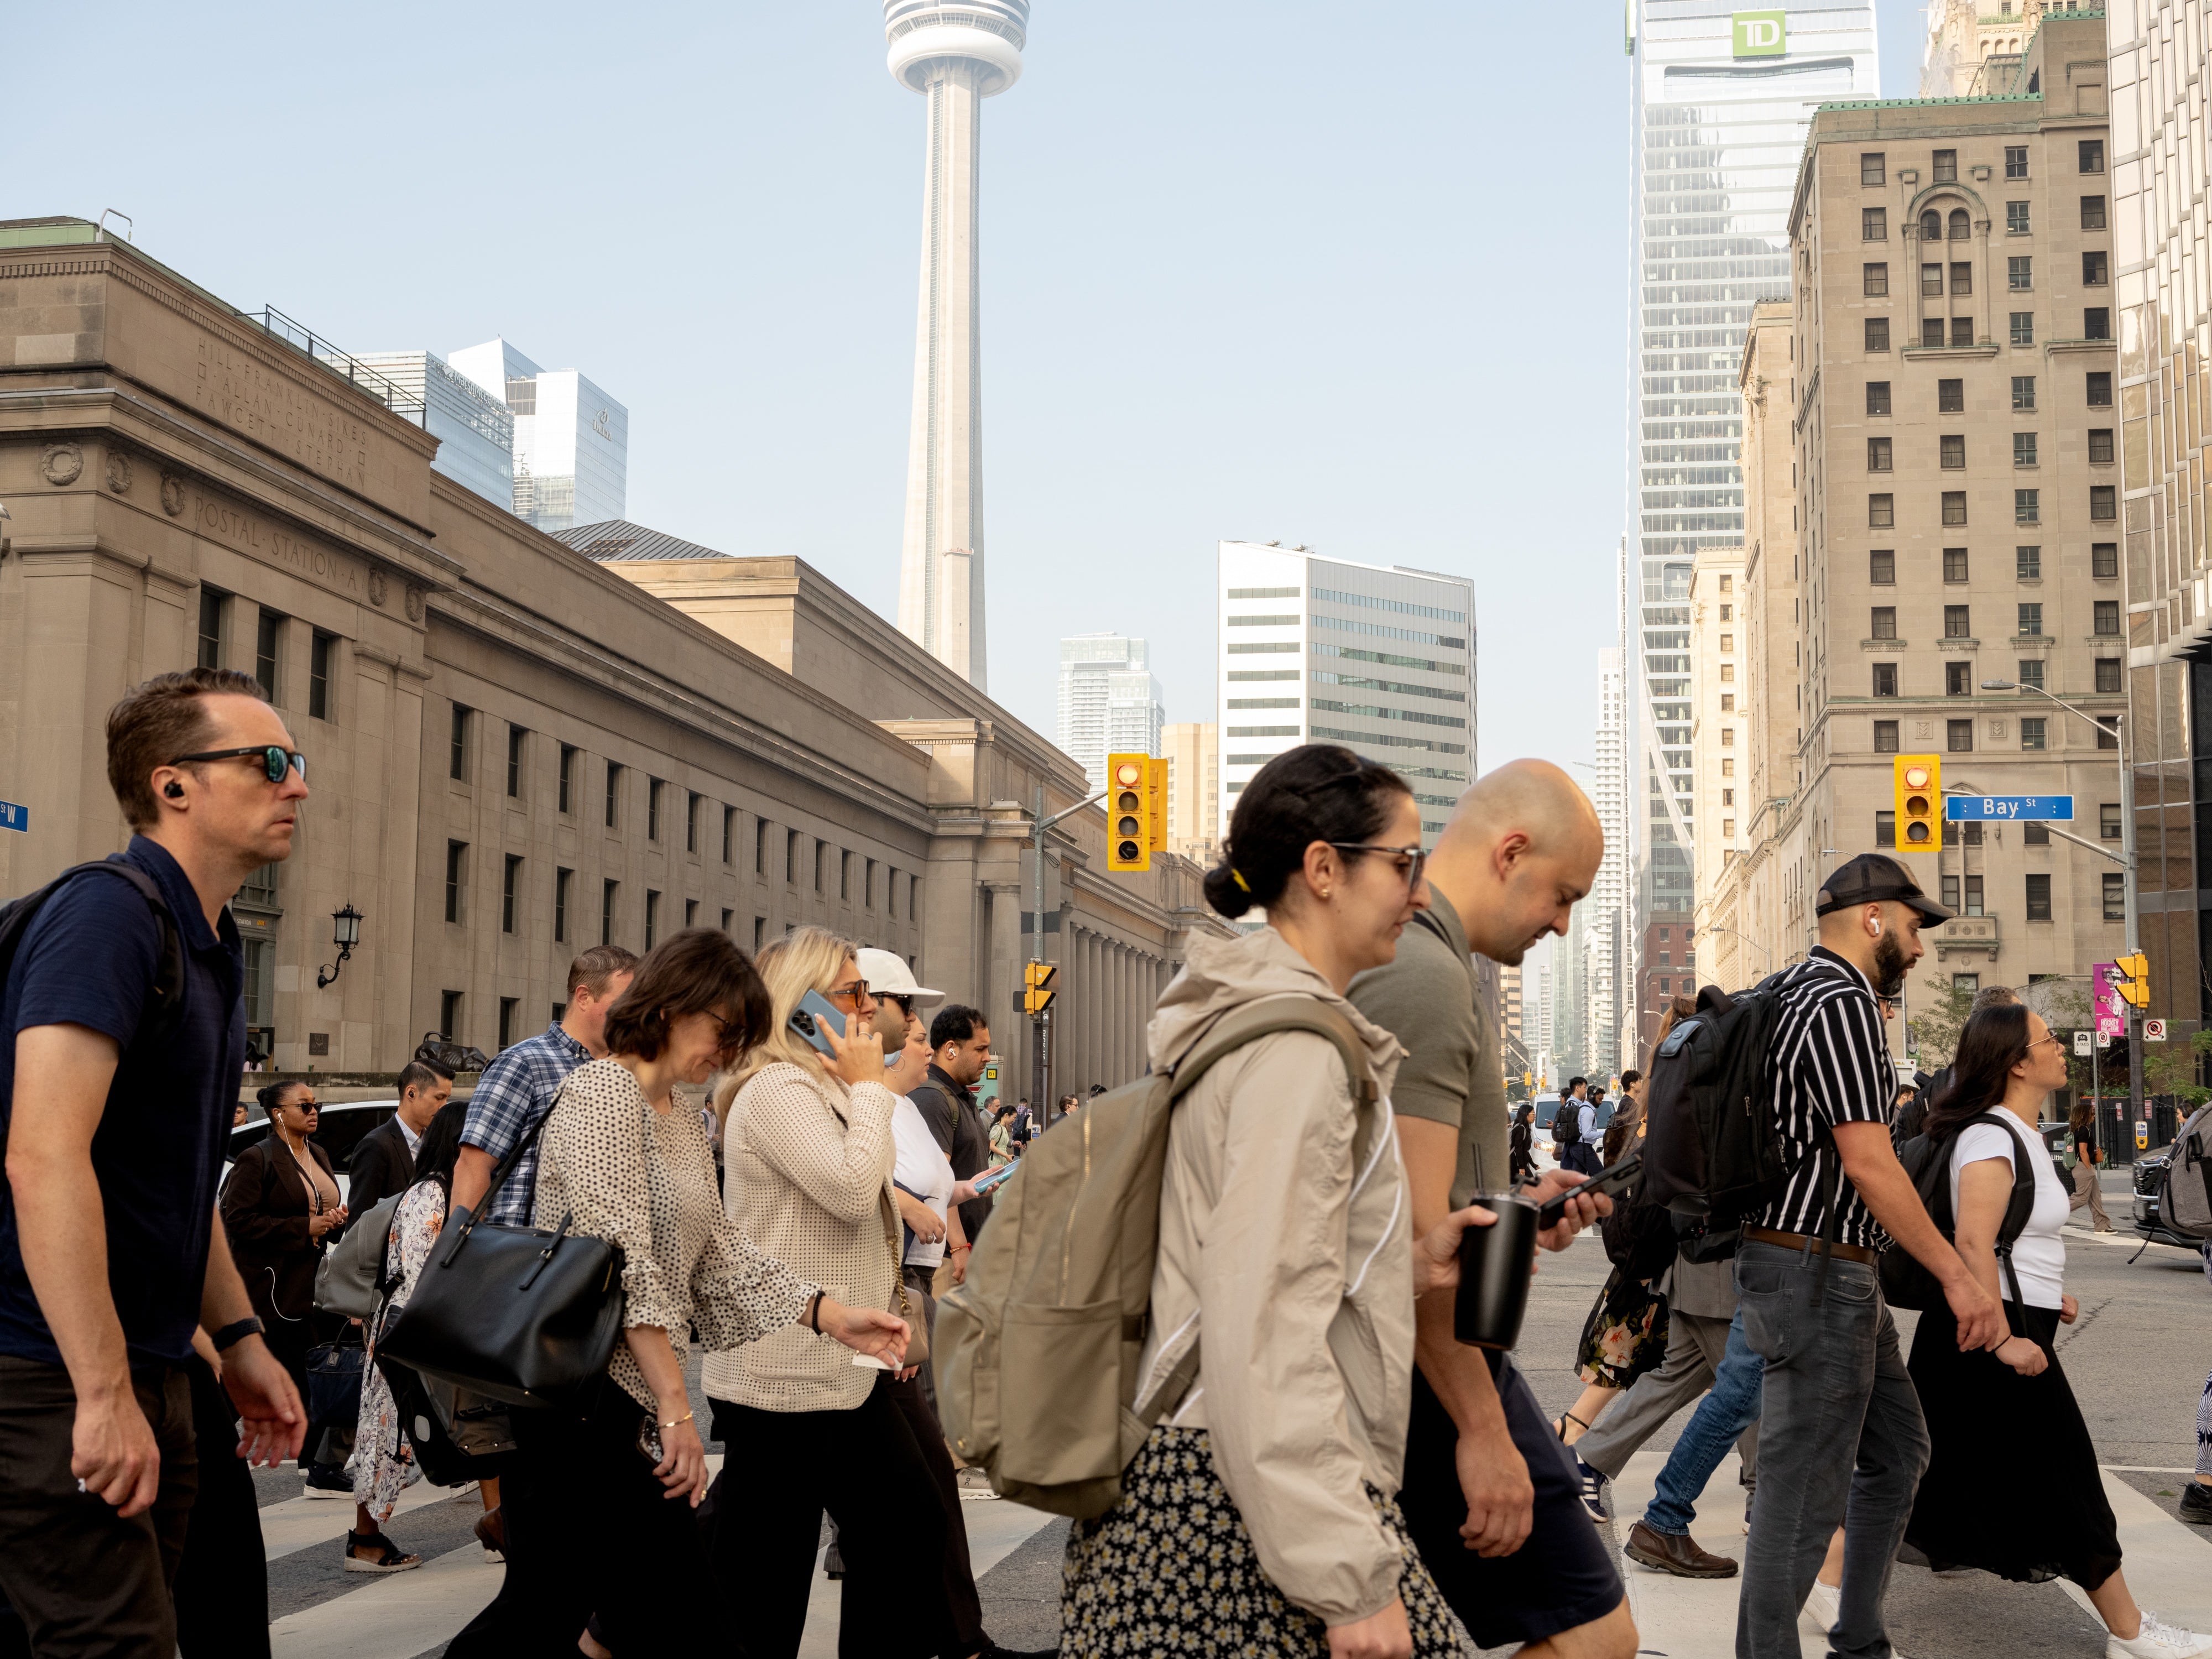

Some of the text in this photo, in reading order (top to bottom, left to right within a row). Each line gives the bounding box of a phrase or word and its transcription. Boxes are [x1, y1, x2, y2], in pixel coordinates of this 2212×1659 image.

[1738, 19, 1780, 47] TD
[199, 337, 366, 445] HILL FRANKLIN SIKES
[222, 376, 343, 453] ALLAN CUNARD
[195, 385, 365, 487] FAWCETT STEPHAN
[195, 497, 357, 591] POSTAL STATION A
[1, 804, 15, 823] St W
[1984, 798, 2036, 818] Bay St
